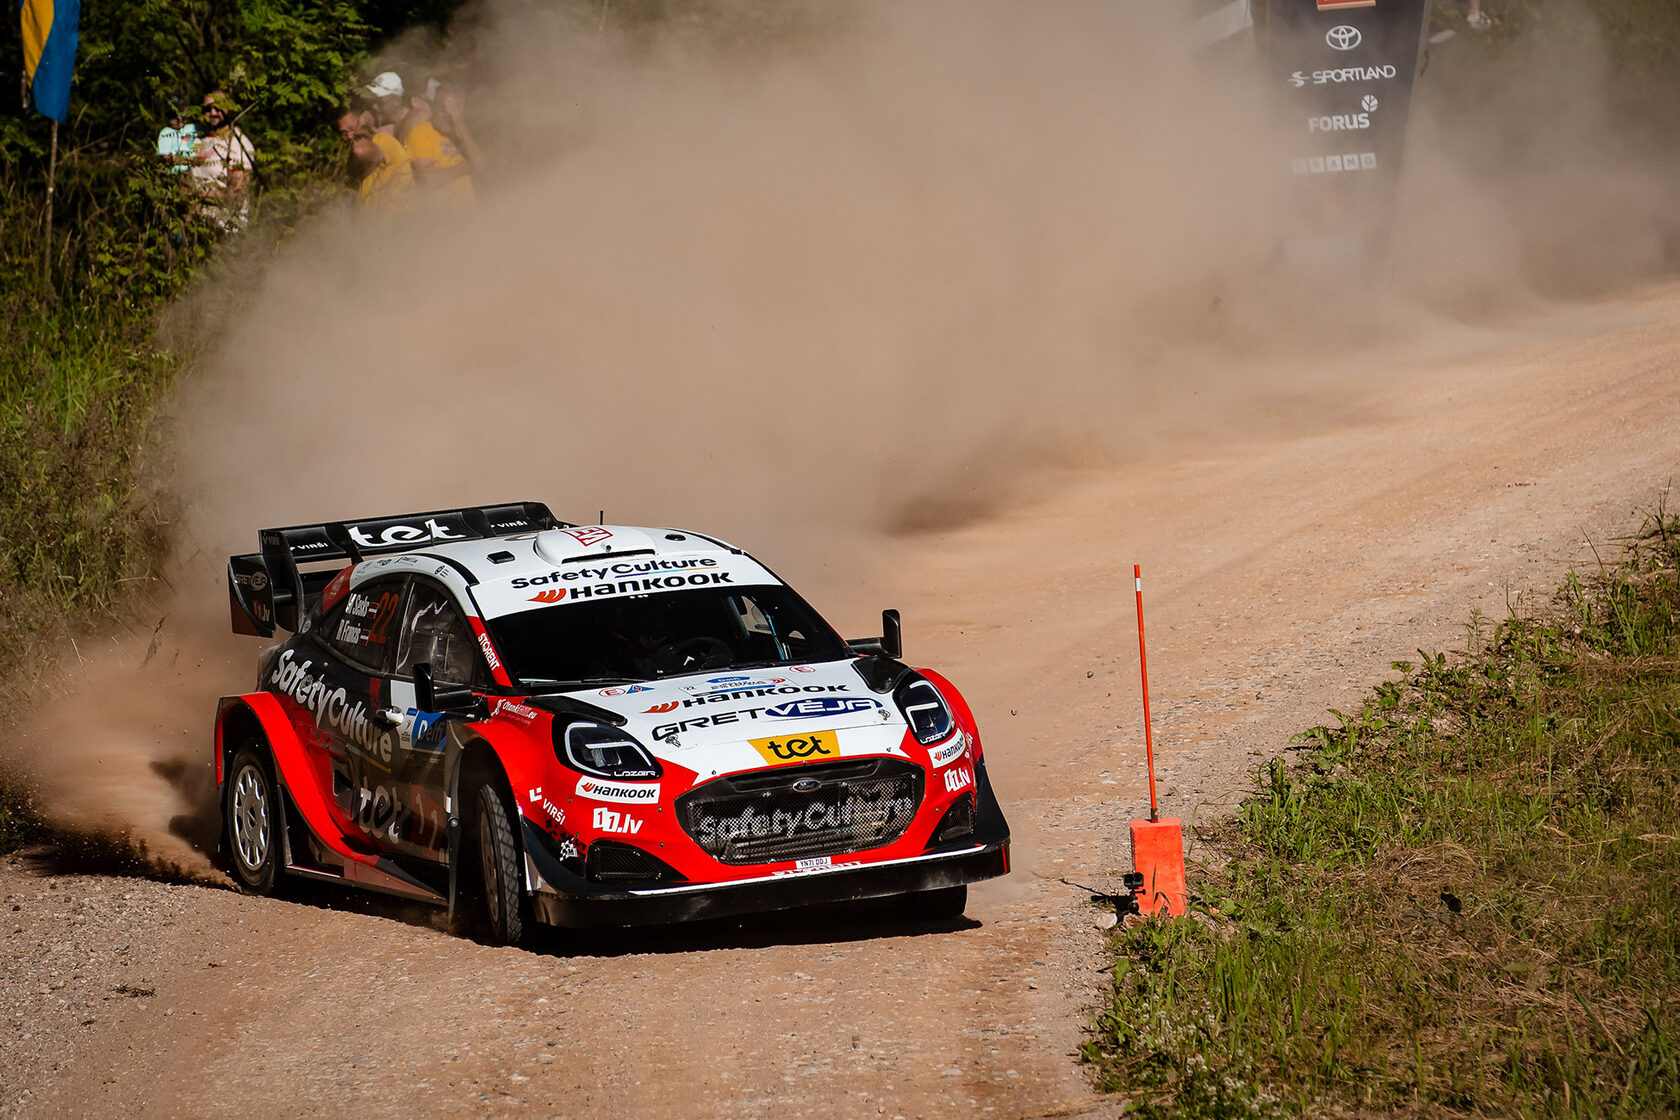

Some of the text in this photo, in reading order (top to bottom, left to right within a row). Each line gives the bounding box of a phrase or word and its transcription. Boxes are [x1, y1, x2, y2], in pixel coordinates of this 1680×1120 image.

[1313, 65, 1396, 84] SPORTLAND
[1308, 113, 1370, 132] FORUS
[348, 519, 467, 547] tet
[511, 558, 718, 589] SafetyCulture
[369, 592, 399, 645] 22
[478, 632, 500, 671] STORENT
[271, 649, 392, 763] SafetyCulture
[767, 735, 831, 760] tet
[542, 798, 567, 826] VIRŠI
[593, 807, 644, 835] 11.lv
[699, 797, 913, 843] SafetyCulre
